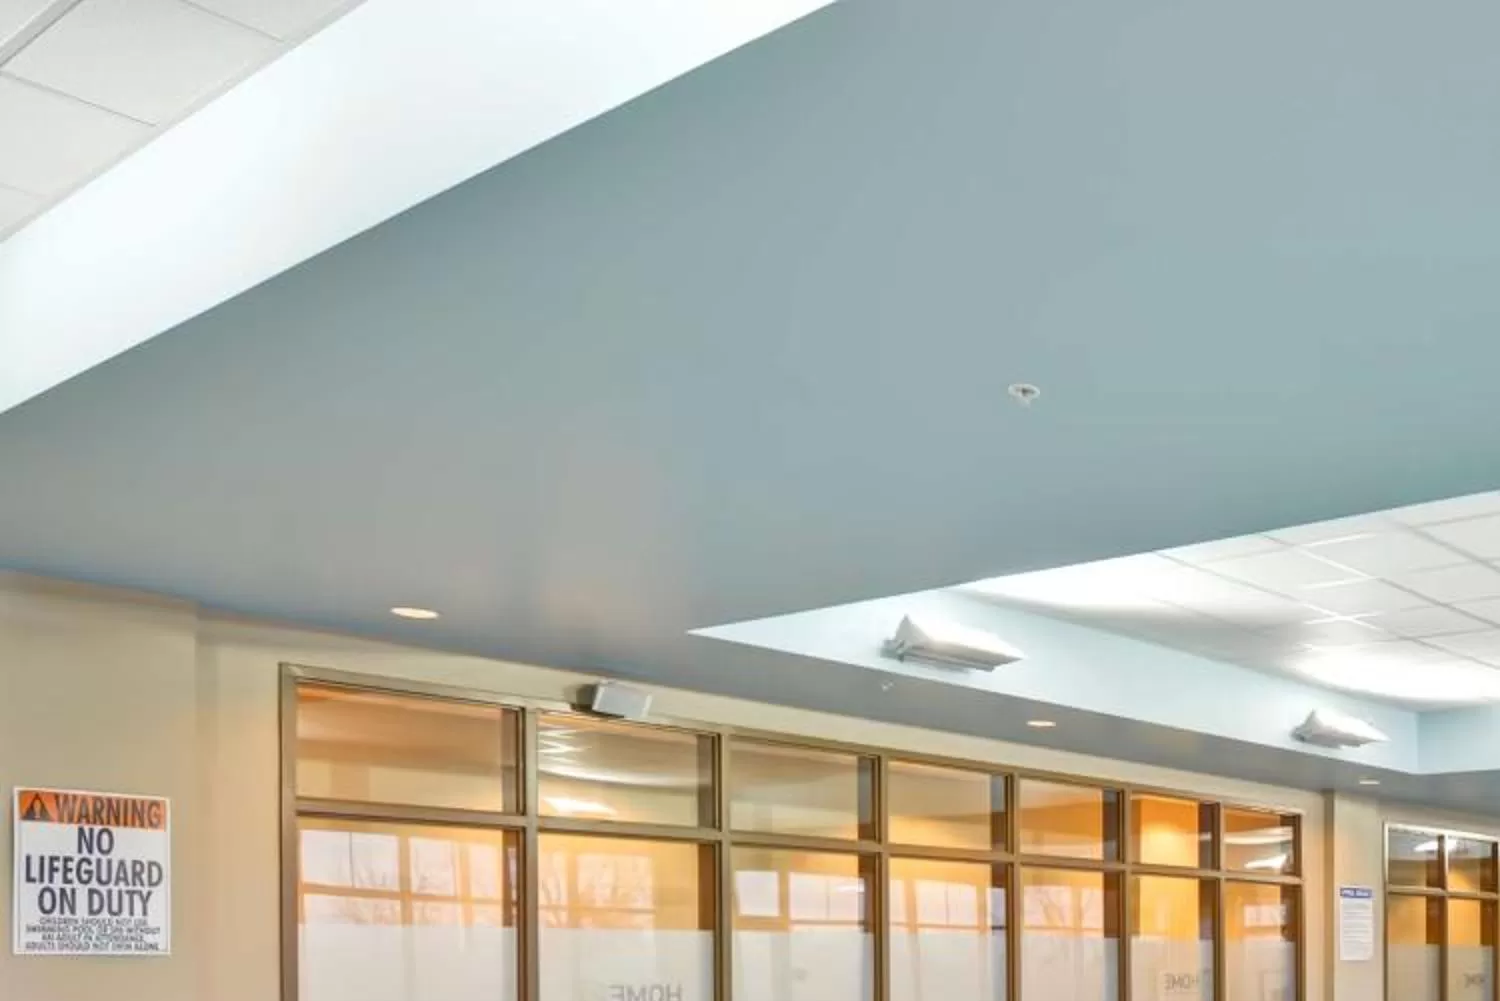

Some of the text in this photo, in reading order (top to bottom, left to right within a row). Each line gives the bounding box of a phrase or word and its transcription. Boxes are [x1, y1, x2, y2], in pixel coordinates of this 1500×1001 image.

[55, 792, 162, 829] WARNING
[77, 826, 114, 855] NO
[25, 854, 163, 887] LIFEGUARD
[38, 886, 153, 917] ON DUTY
